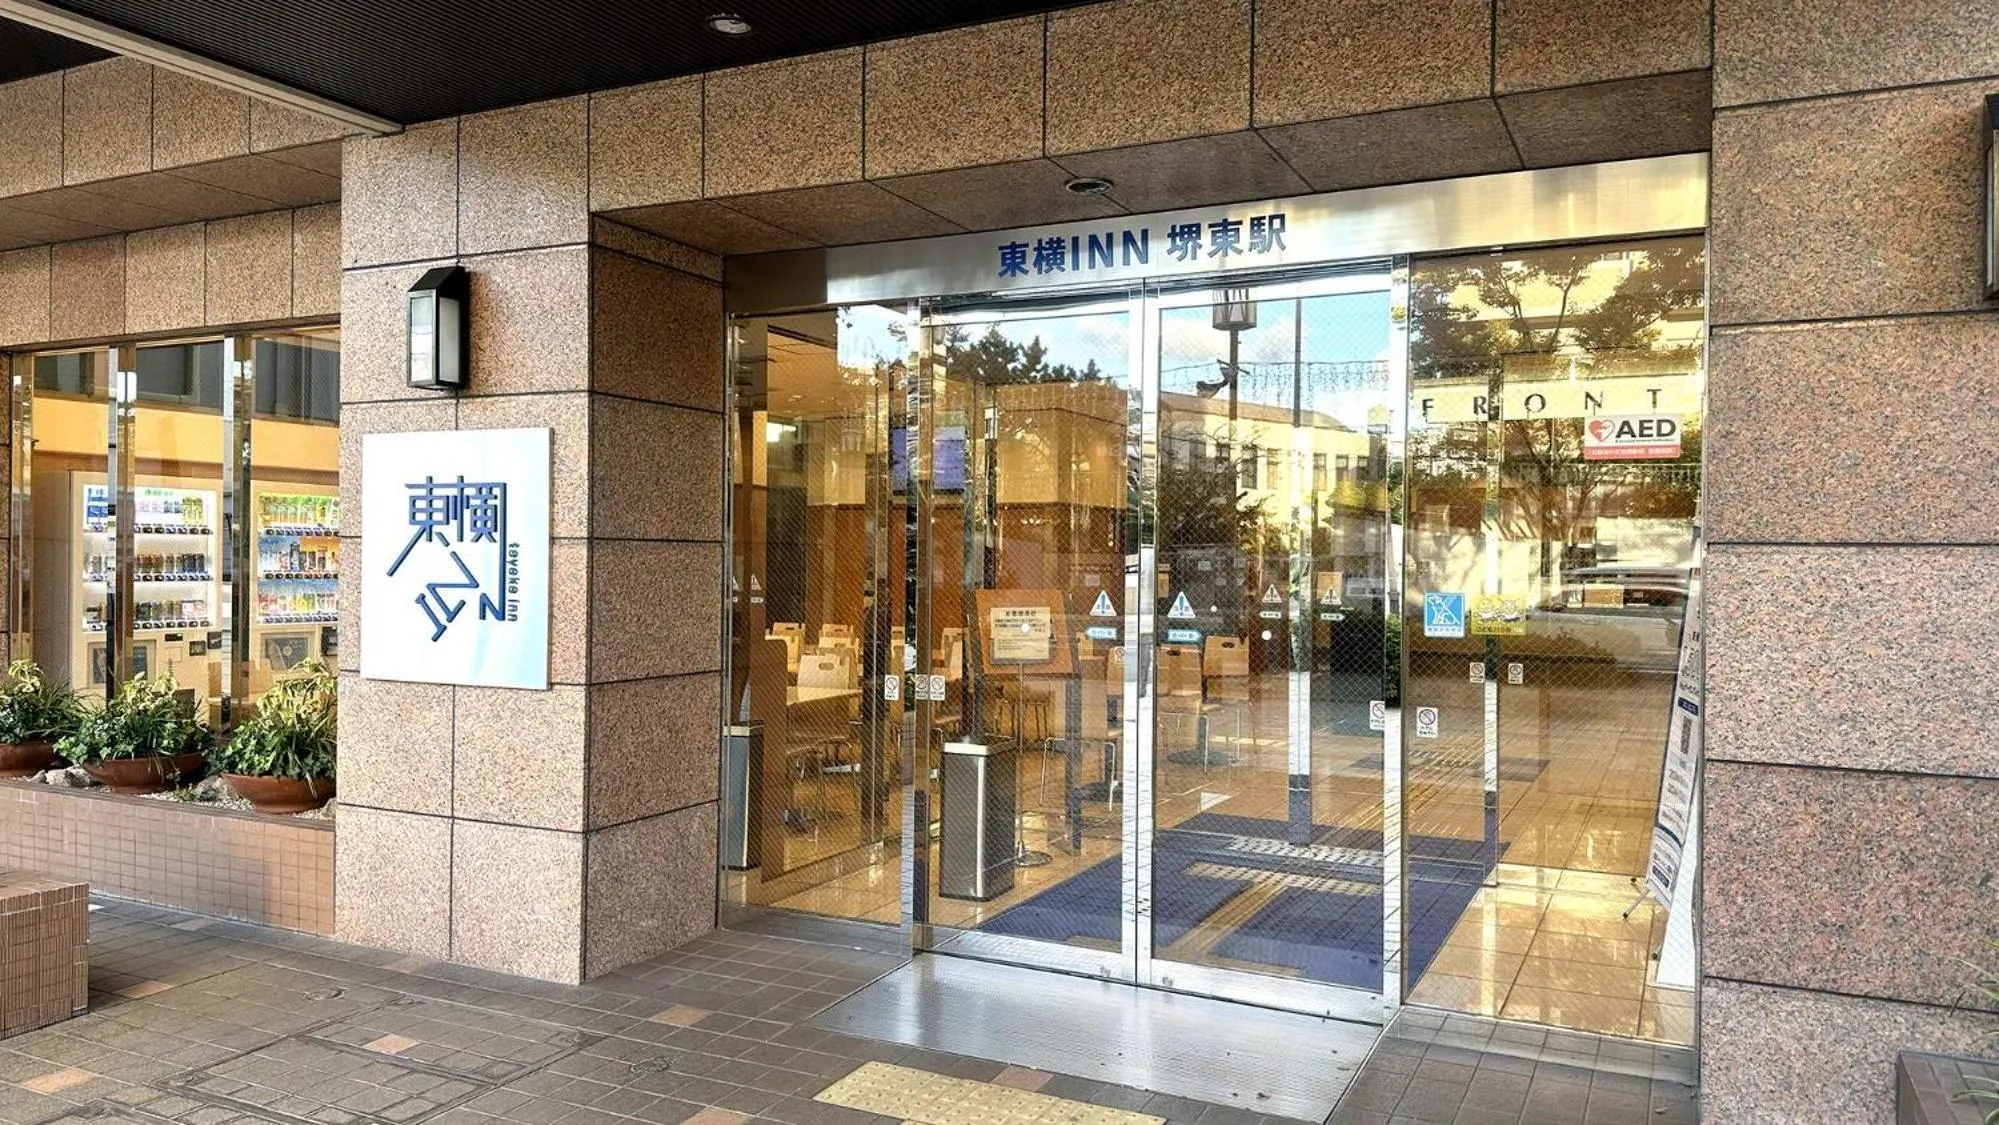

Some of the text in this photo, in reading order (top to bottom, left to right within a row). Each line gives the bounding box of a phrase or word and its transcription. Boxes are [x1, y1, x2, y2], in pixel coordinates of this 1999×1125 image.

[997, 212, 1287, 278] 東横INN 堺東駅
[1421, 388, 1662, 417] FRONT
[1615, 418, 1677, 438] AED
